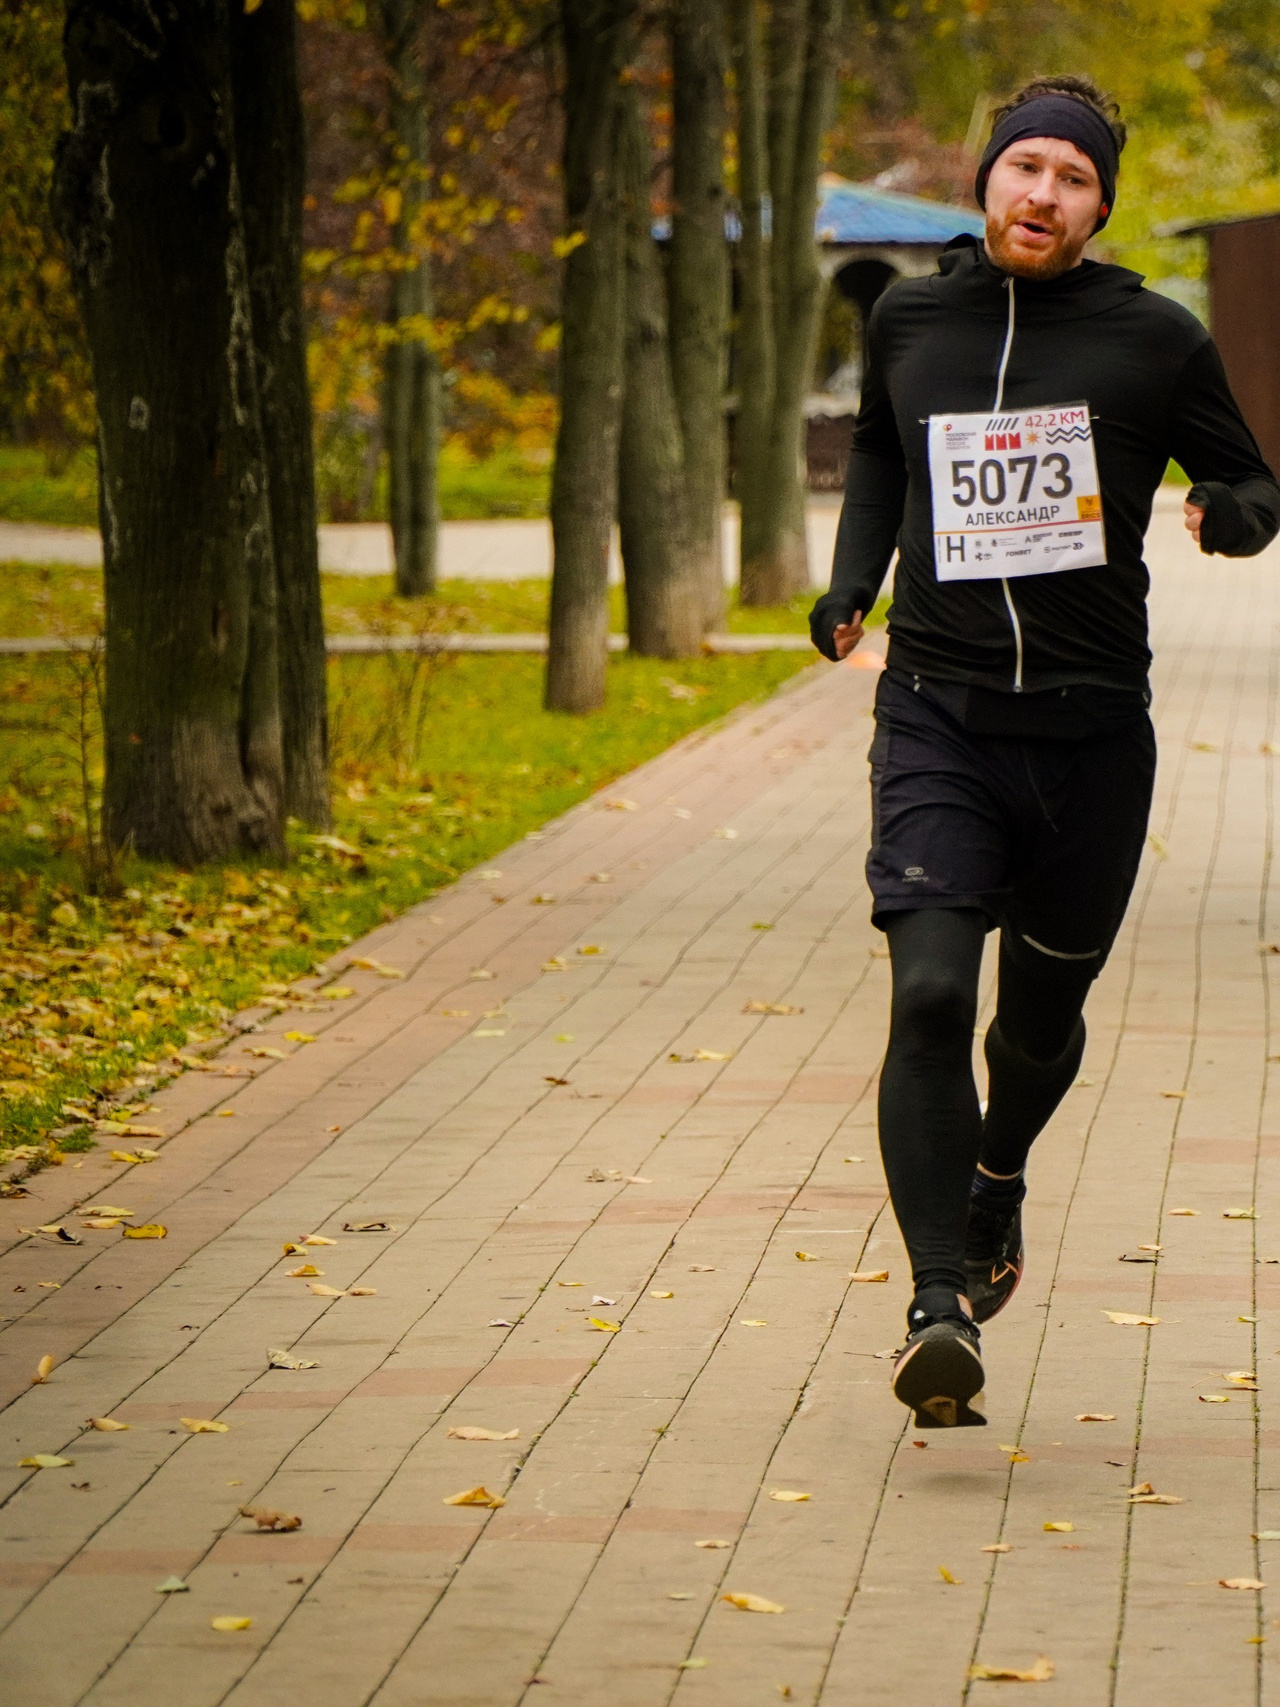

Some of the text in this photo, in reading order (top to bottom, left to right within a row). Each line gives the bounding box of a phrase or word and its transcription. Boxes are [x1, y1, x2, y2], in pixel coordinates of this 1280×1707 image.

[1025, 413, 1056, 428] 42,2
[951, 452, 1073, 508] 5073
[966, 505, 1060, 527] АЛЕКСАНДР
[1005, 549, 1032, 557] FONBET
